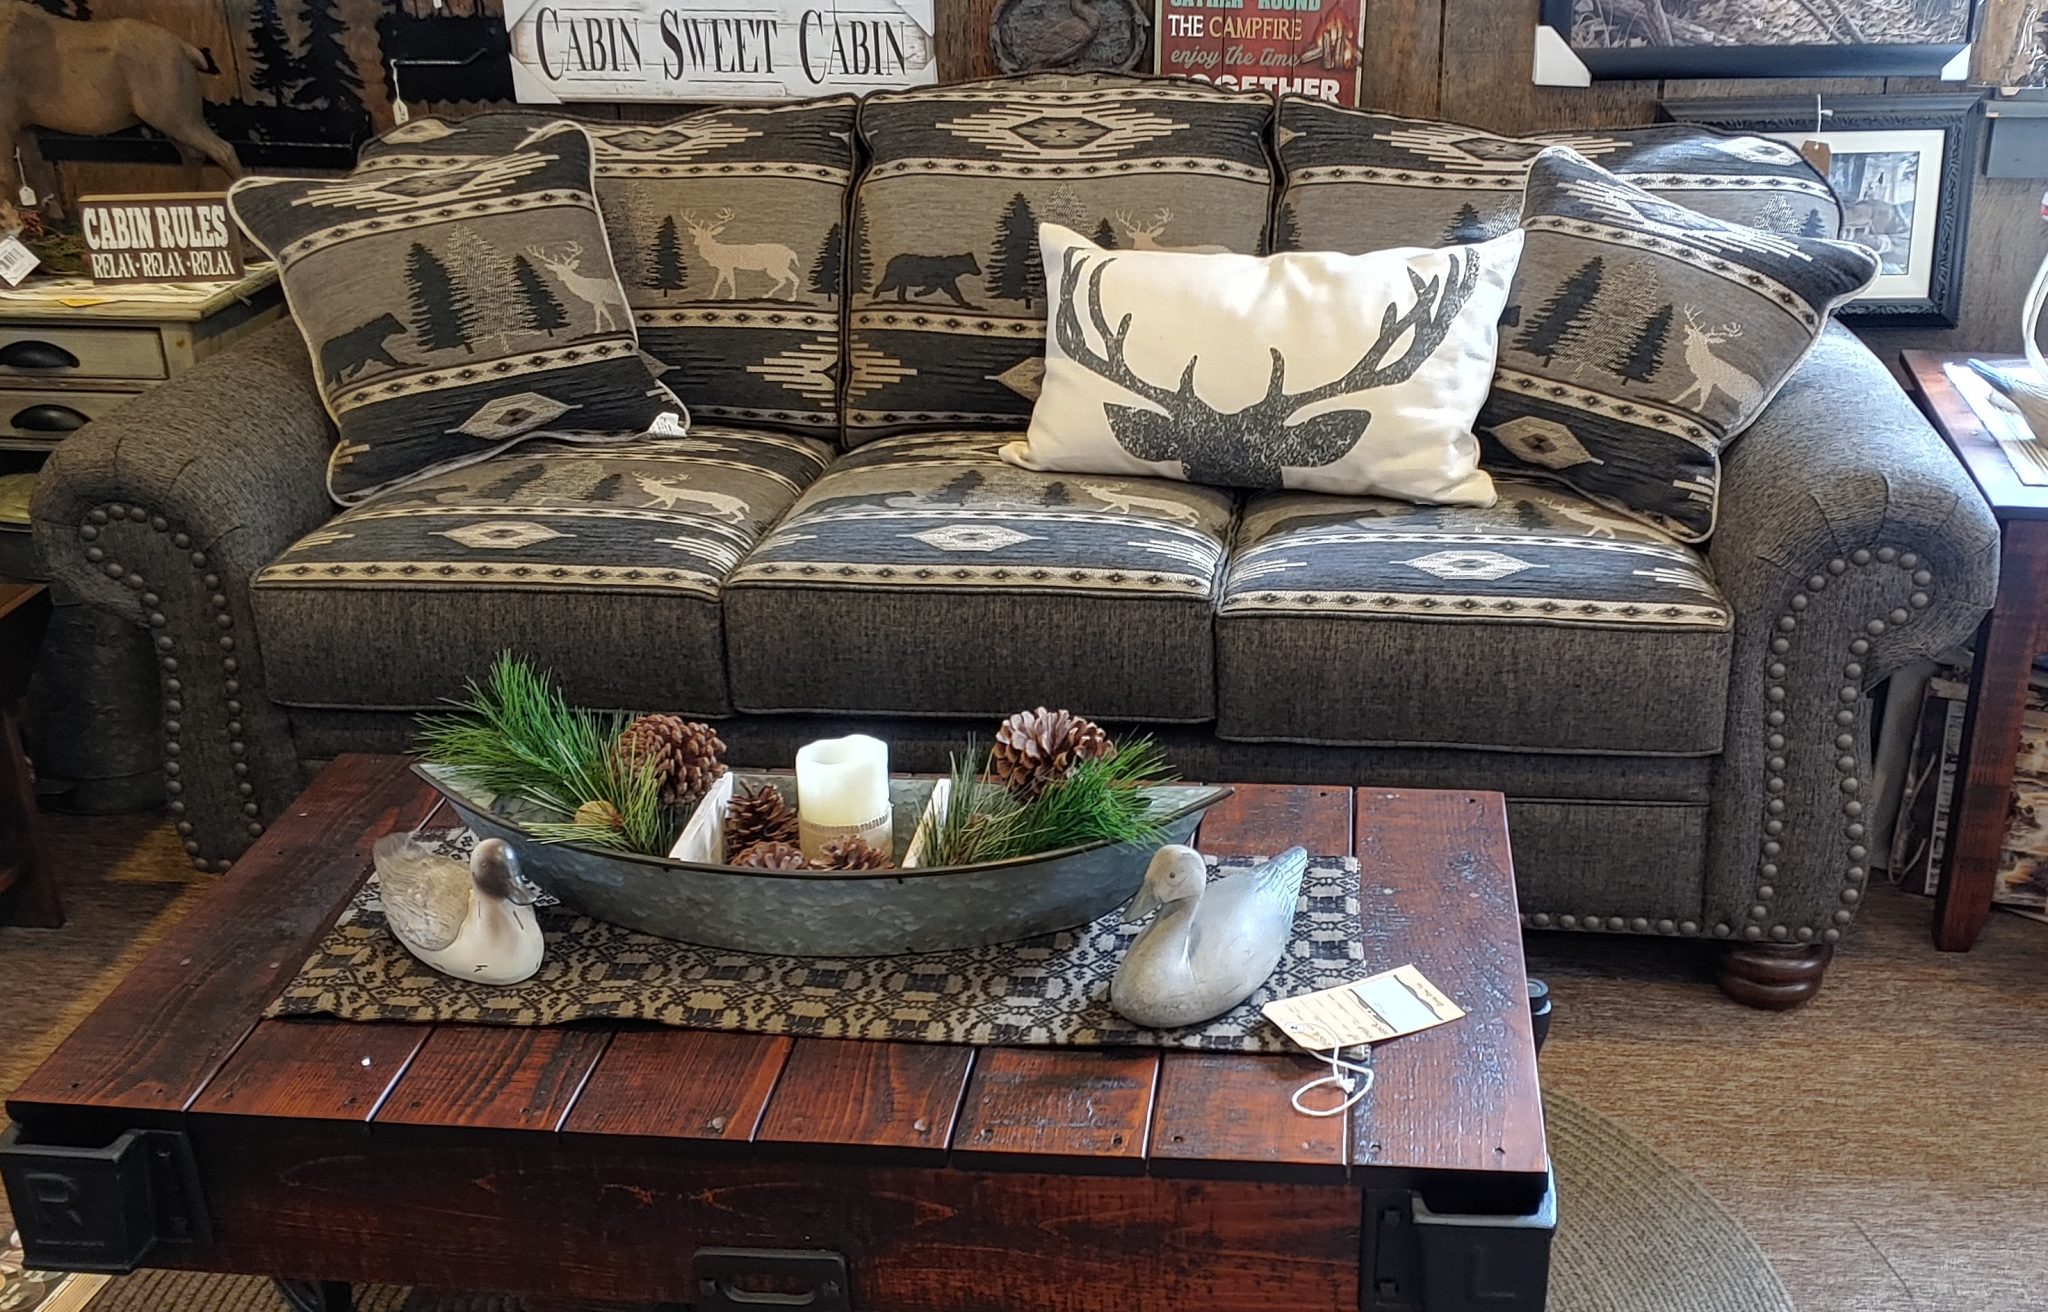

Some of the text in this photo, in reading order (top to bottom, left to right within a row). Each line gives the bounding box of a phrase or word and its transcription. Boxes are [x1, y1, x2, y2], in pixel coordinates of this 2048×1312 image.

[1168, 14, 1302, 41] THE CAMPFIRE
[535, 7, 910, 84] CABIN SWEET CABIN
[1170, 44, 1300, 68] enjoy the time
[1168, 73, 1340, 104] GETHER
[83, 205, 229, 250] CABIN RULES
[91, 250, 235, 279] RELAX RELAX RELAX
